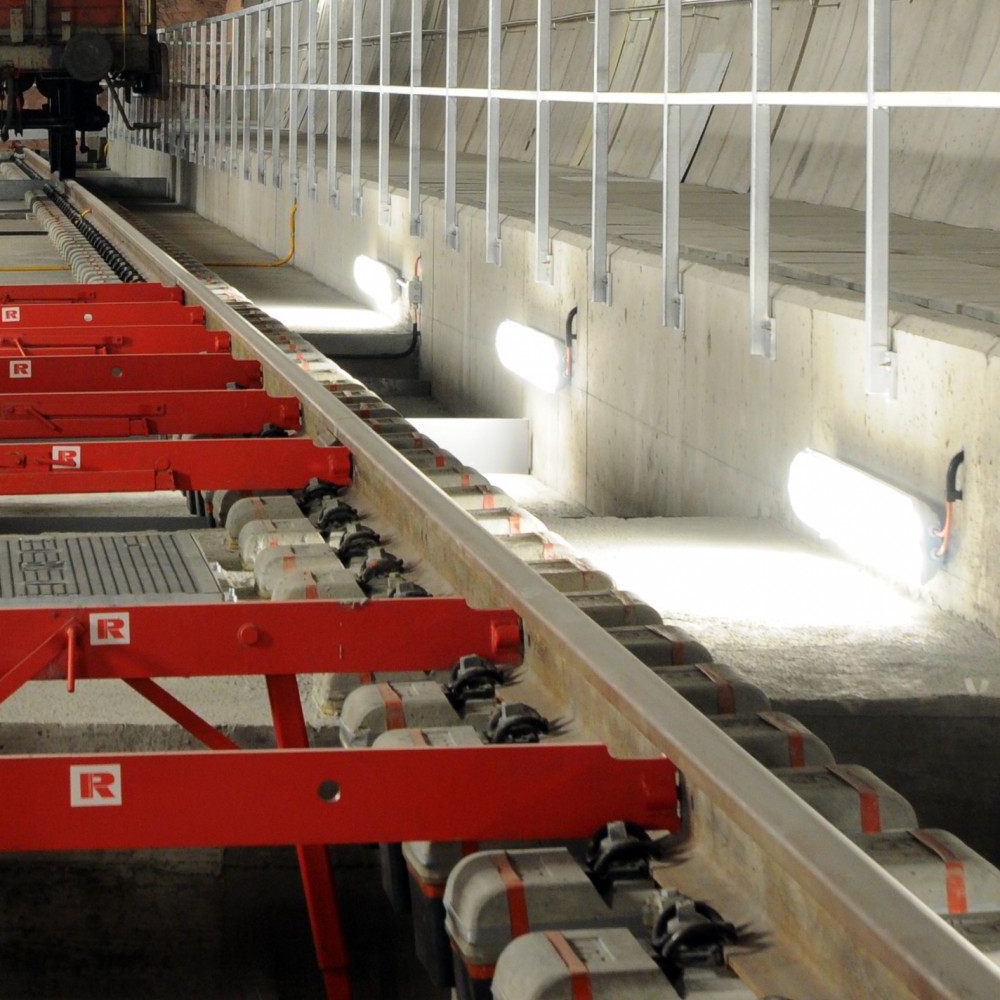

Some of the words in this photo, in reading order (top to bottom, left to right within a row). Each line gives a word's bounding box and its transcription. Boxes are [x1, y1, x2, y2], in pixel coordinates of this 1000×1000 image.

[13, 364, 29, 375] R
[96, 618, 125, 640] R
[80, 772, 116, 799] R
